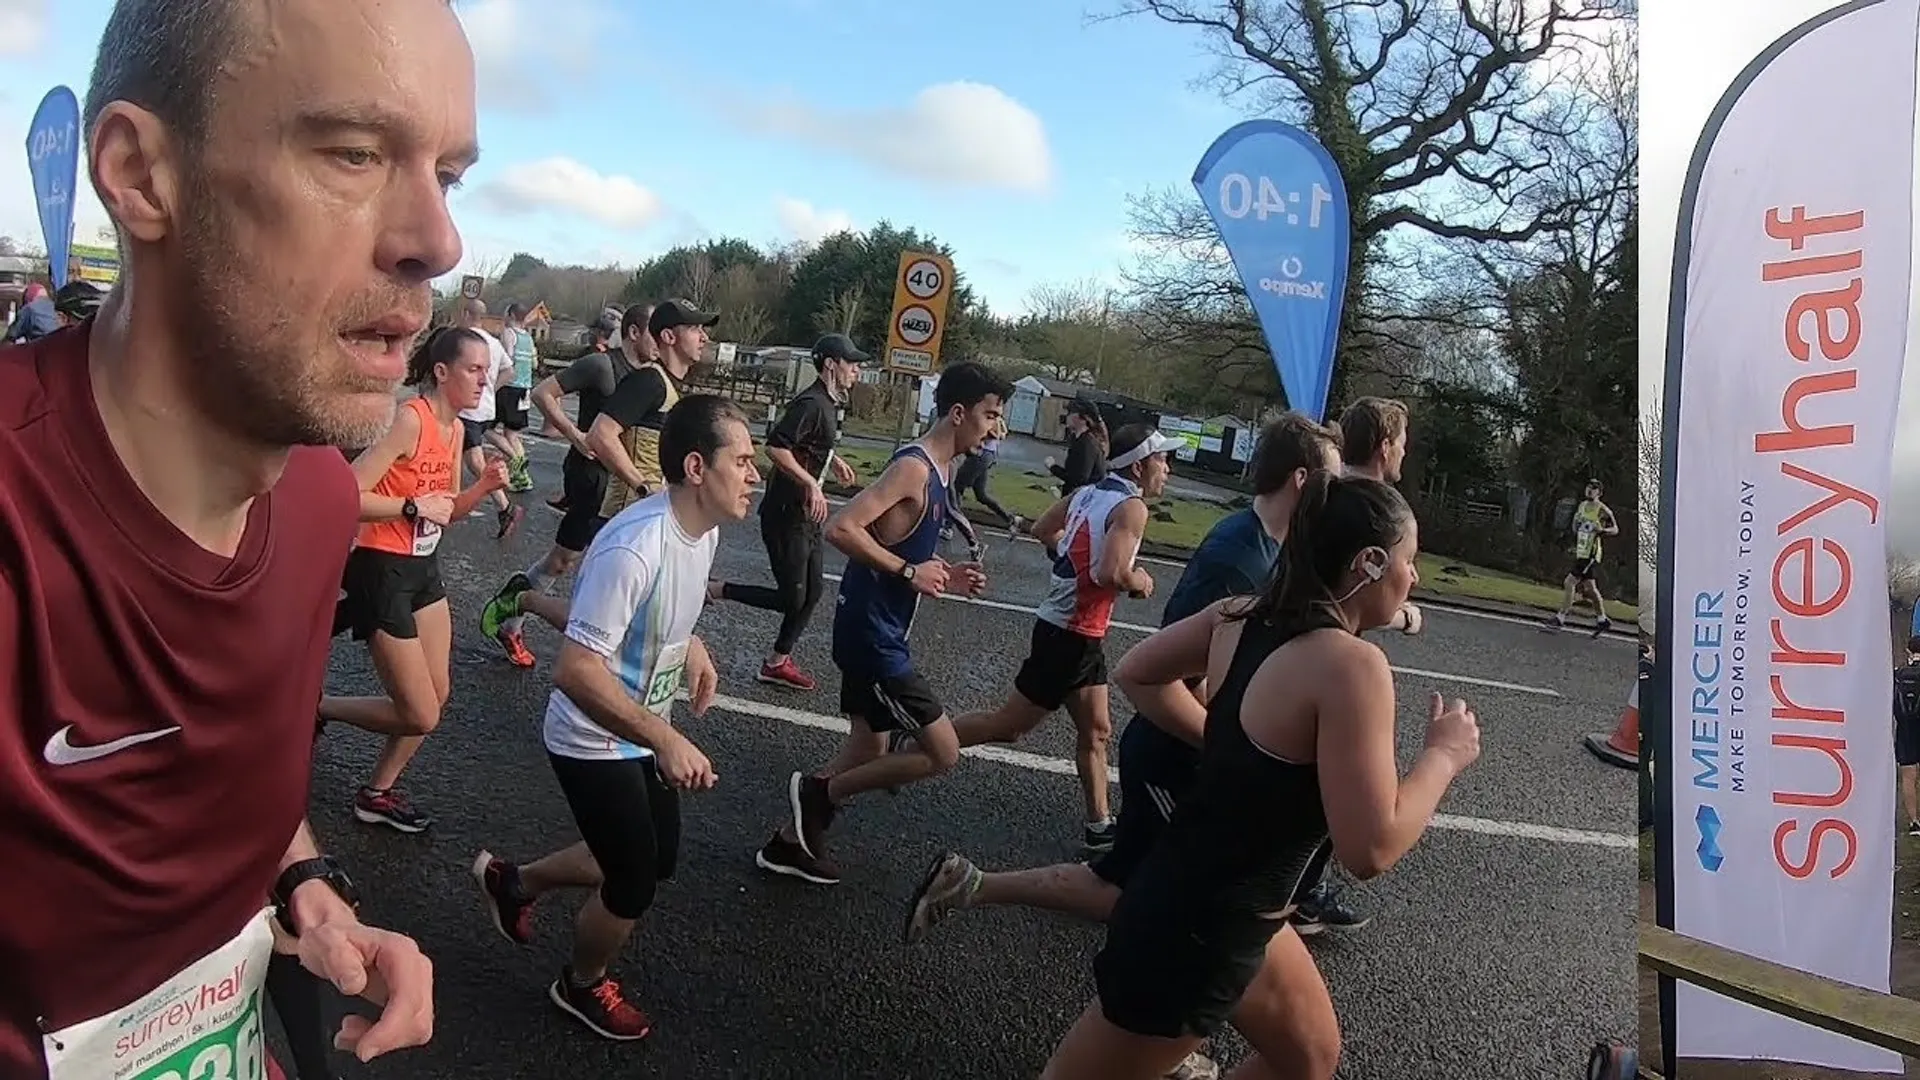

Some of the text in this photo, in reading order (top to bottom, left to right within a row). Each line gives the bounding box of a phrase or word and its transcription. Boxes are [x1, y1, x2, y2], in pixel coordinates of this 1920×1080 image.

[909, 270, 939, 289] 40
[1731, 480, 1756, 792] MAKE TOMORROW, TODAY
[1754, 205, 1881, 881] surreyhalf
[1691, 591, 1725, 792] MERCER
